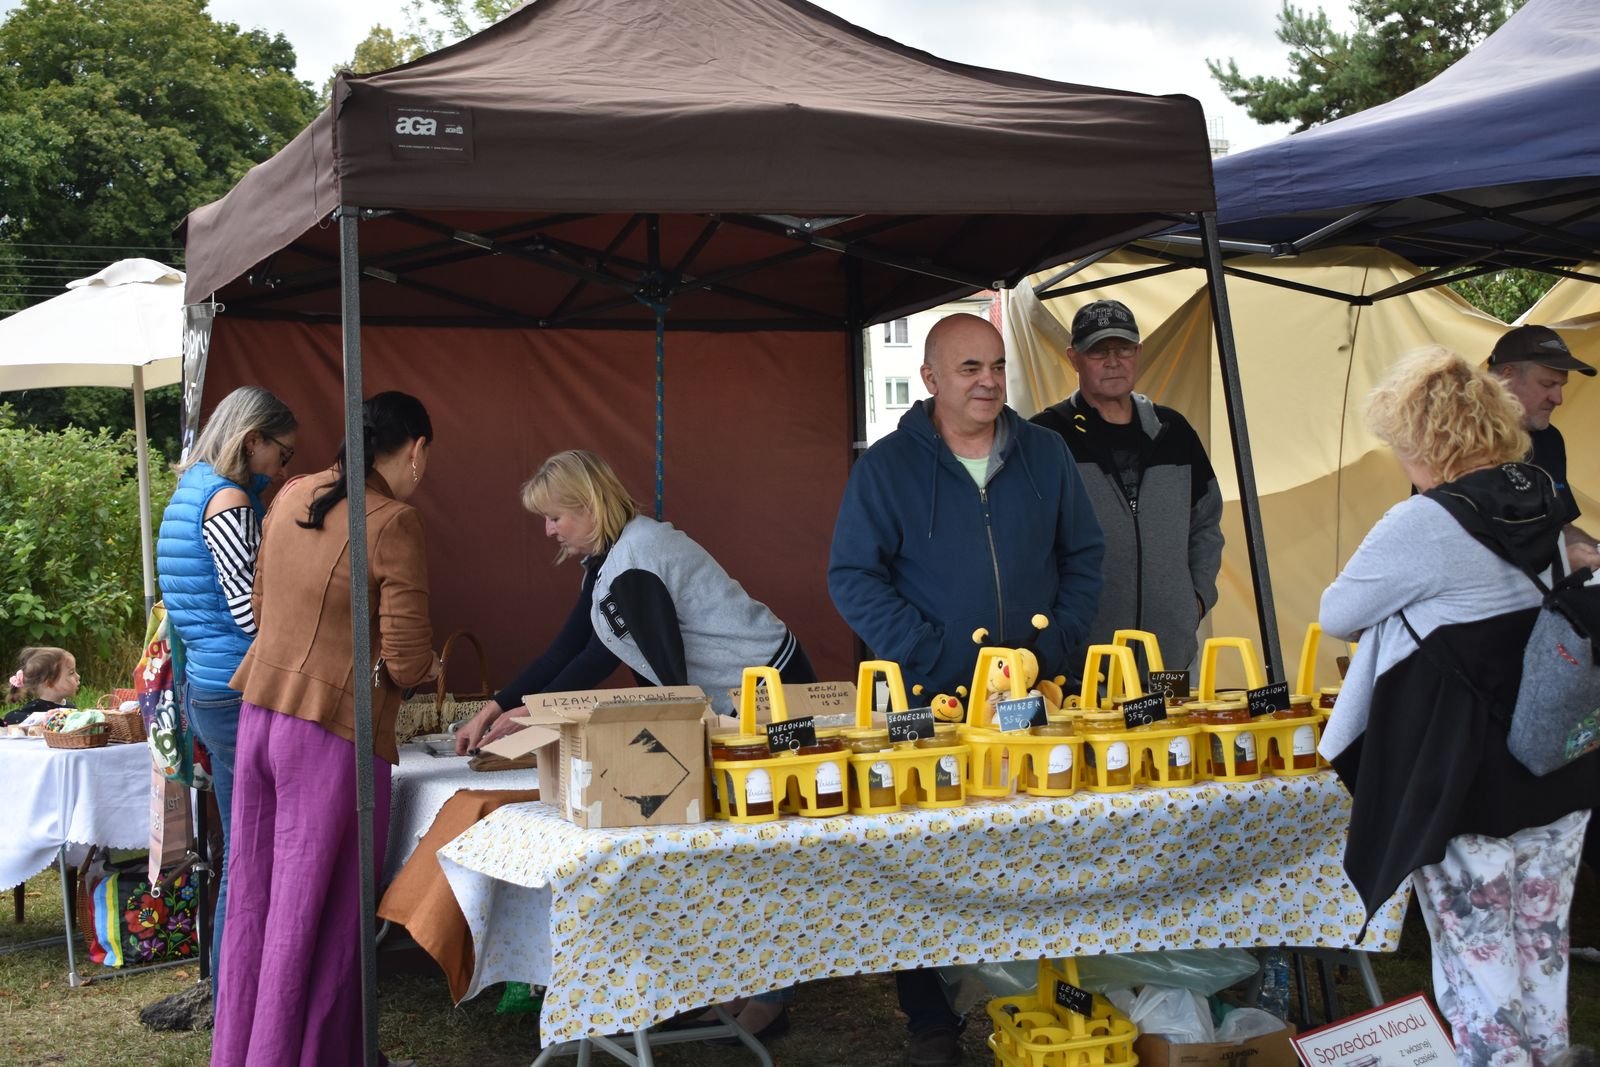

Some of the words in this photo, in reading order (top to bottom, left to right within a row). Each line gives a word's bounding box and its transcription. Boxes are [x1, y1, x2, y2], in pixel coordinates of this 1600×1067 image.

[1152, 673, 1184, 681] LIPOWY
[542, 694, 598, 707] LIZAKI
[1000, 701, 1041, 713] MNISZEK
[1125, 697, 1163, 713] AKACJOWY
[1313, 1028, 1382, 1065] Sprzedaż
[1378, 1013, 1427, 1041] Miodu
